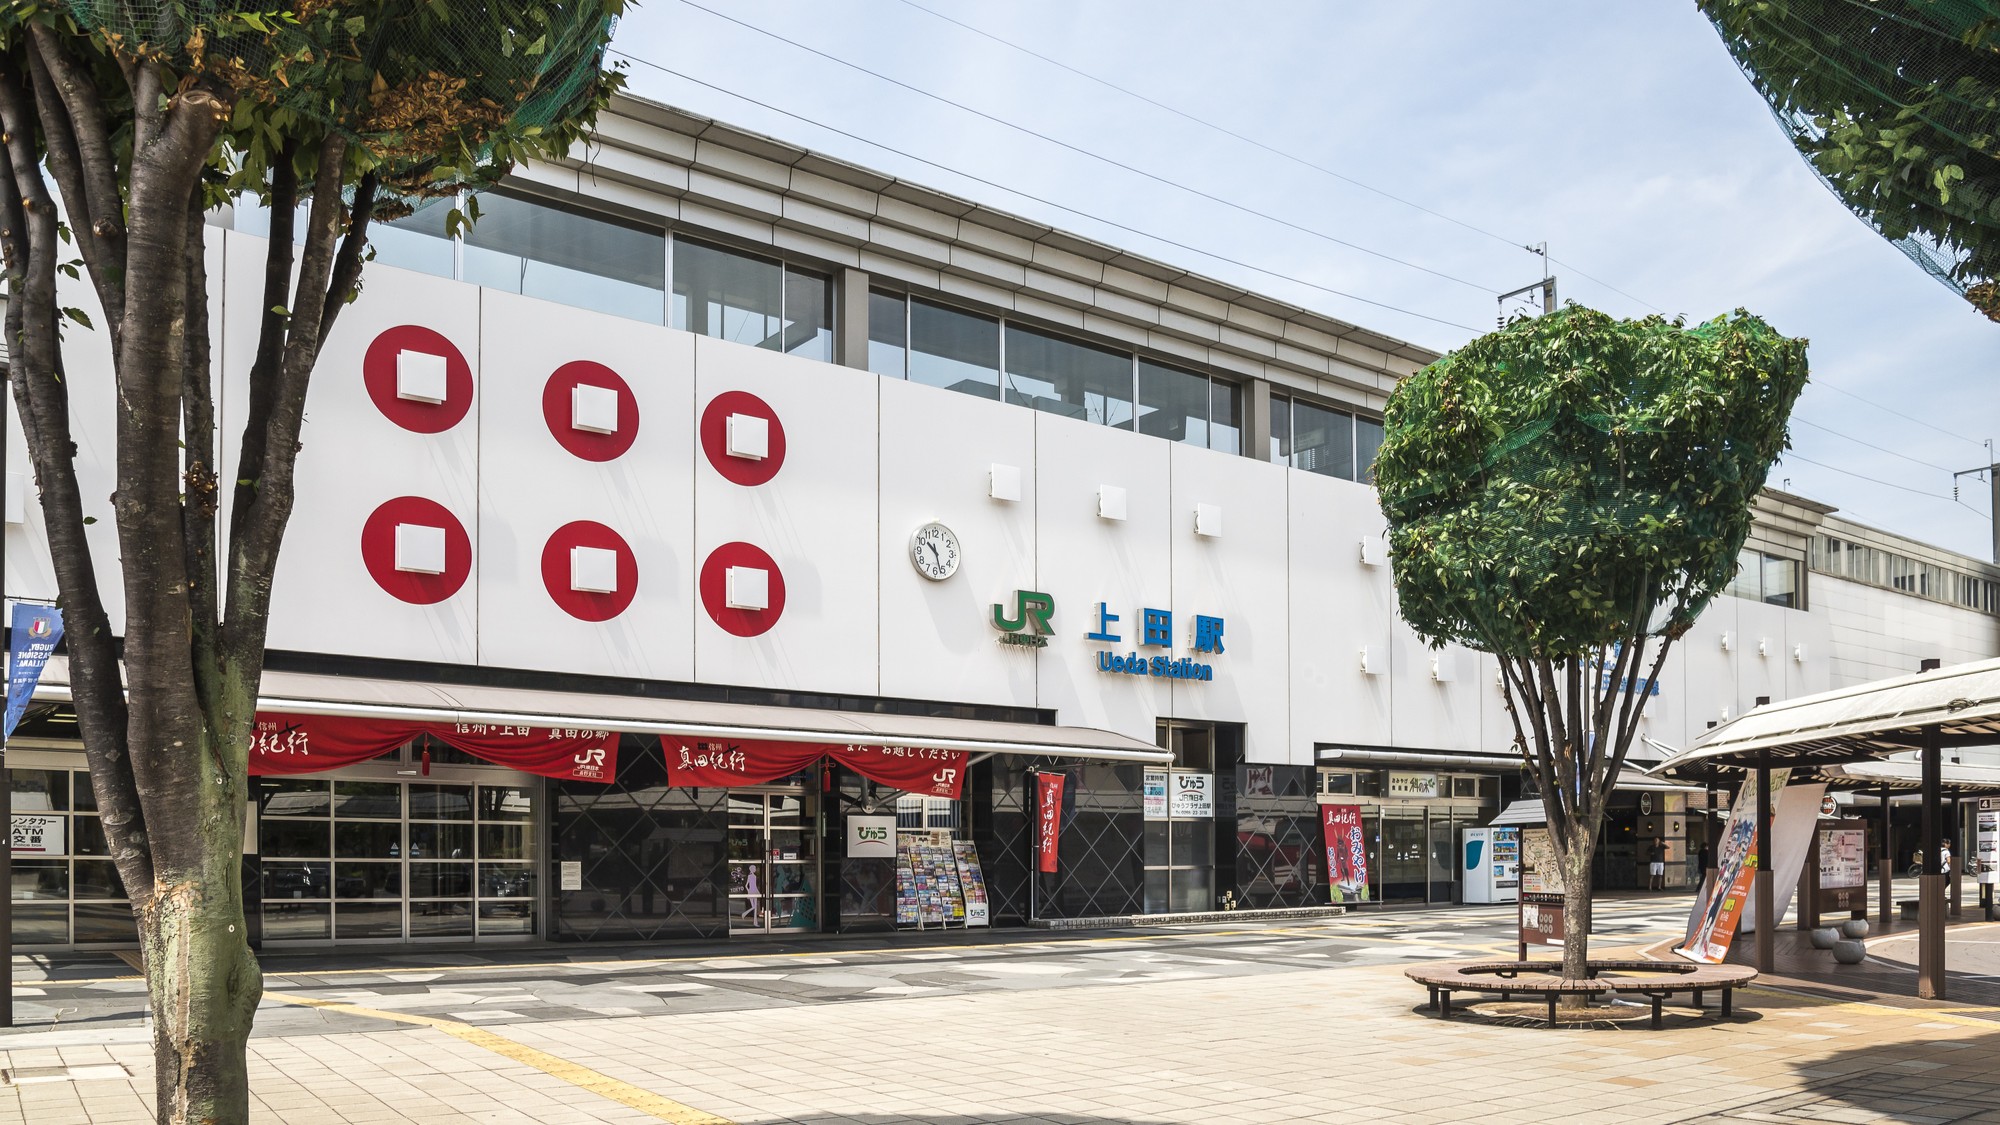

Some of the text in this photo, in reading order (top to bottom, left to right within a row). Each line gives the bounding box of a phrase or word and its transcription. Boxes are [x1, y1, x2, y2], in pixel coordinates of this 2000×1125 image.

[925, 530, 931, 539] 11
[932, 529, 939, 539] 12
[941, 532, 944, 541] 1
[918, 536, 926, 546] 10
[945, 539, 951, 549] 2
[916, 545, 922, 555] 9
[948, 549, 954, 559] 3
[919, 555, 925, 565] 8
[945, 559, 951, 568] 4
[925, 563, 931, 572] 7
[932, 566, 938, 576] 6
[940, 565, 946, 574] 5
[989, 589, 1056, 632] JR
[1087, 601, 1226, 655] 上田駅
[1099, 650, 1213, 681] Ueda Station
[258, 721, 277, 731] 信州
[574, 748, 606, 766] JR
[677, 745, 746, 772] 真田紀行
[932, 768, 957, 784] JR
[1178, 775, 1205, 789] びゅう
[1981, 800, 1989, 808] 4
[1042, 788, 1055, 854] 真田紀行
[857, 826, 888, 840] びゅう
[13, 835, 42, 843] 交番
[1350, 826, 1367, 883] おみやげ
